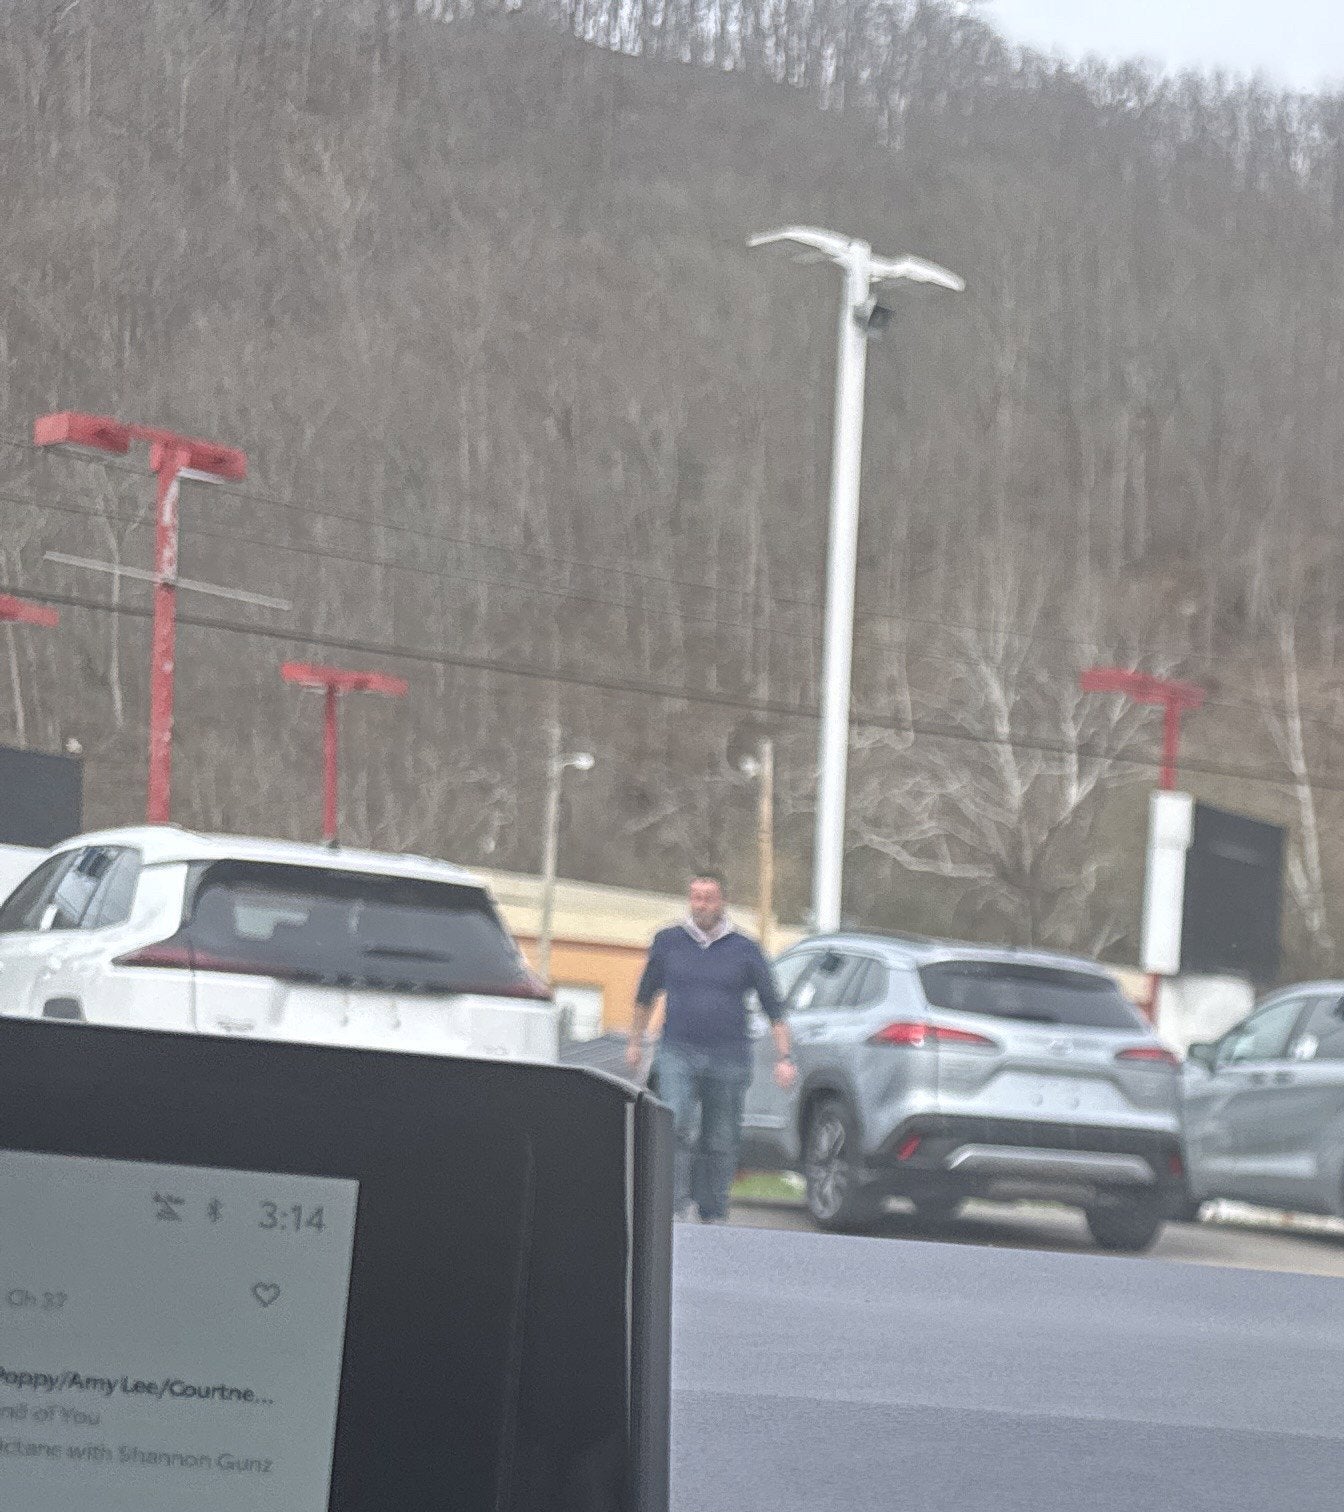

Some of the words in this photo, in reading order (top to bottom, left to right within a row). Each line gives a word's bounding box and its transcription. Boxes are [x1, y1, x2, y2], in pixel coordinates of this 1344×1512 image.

[258, 1201, 326, 1232] 3:14
[0, 1402, 28, 1420] nd
[59, 1406, 101, 1426] You
[118, 1445, 213, 1469] Shannon
[216, 1452, 274, 1473] Gunz
